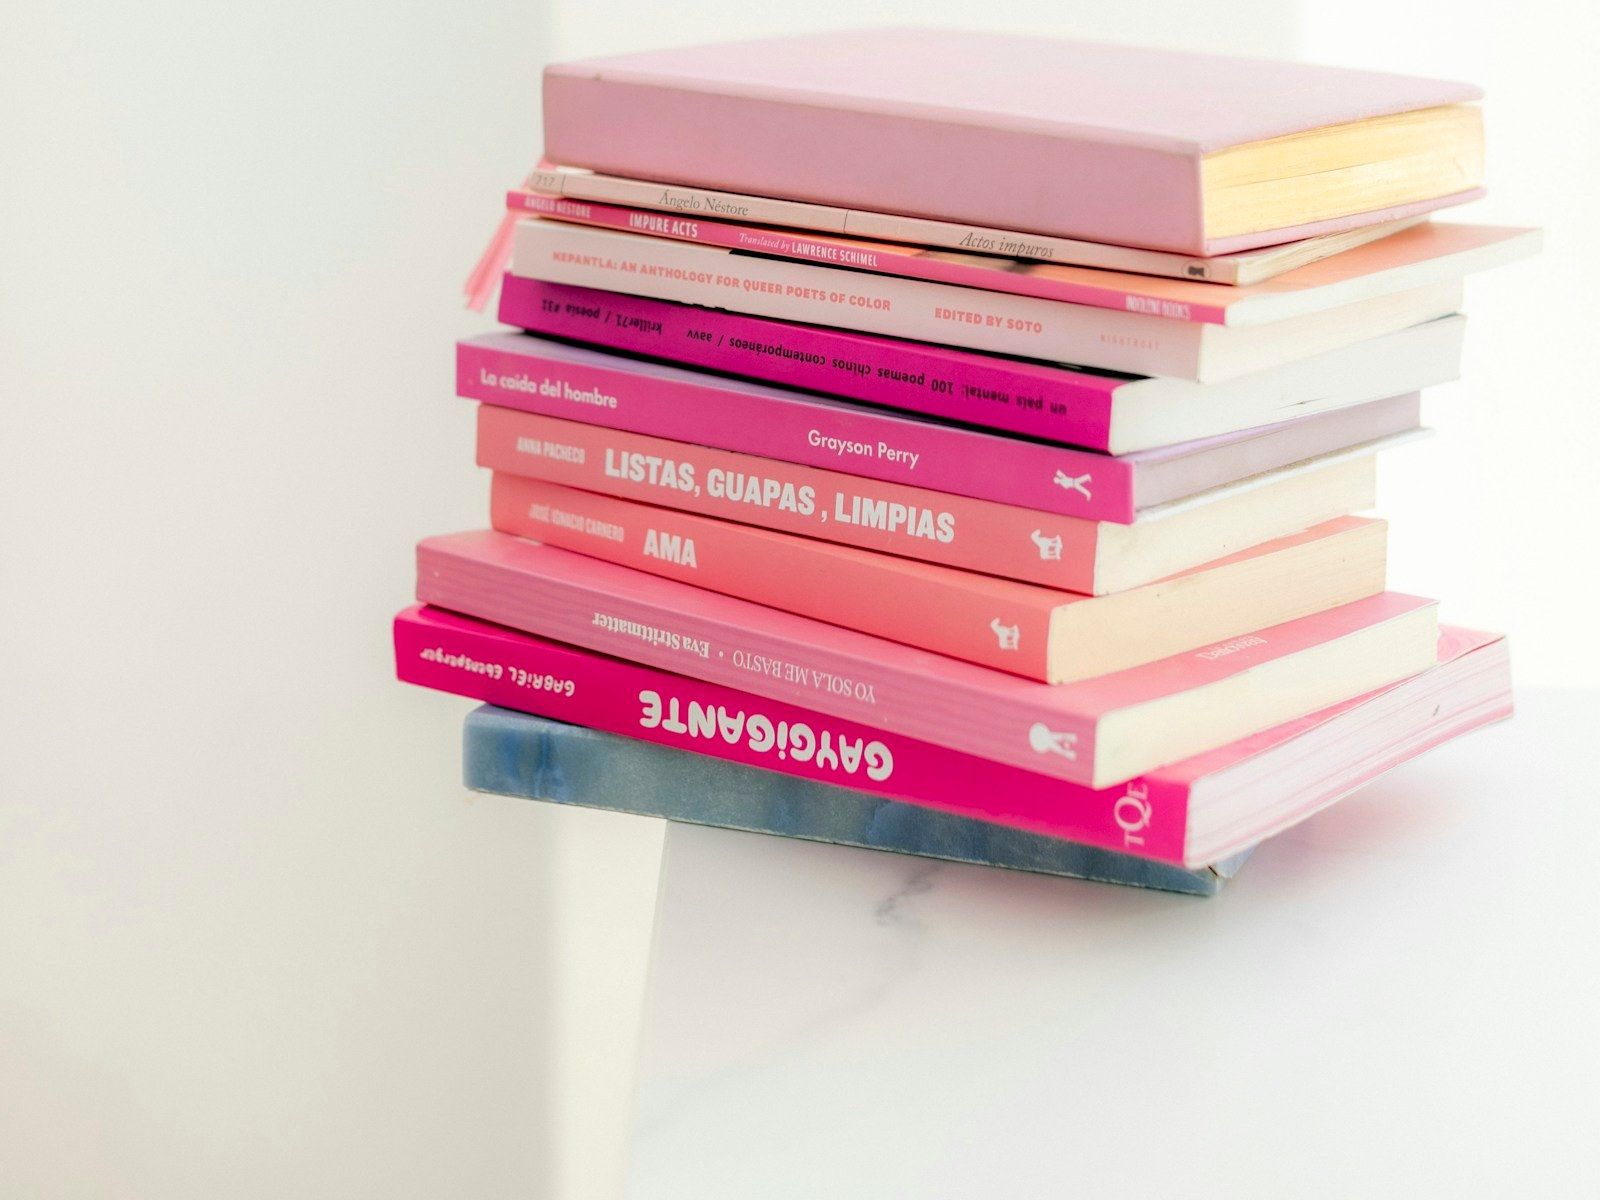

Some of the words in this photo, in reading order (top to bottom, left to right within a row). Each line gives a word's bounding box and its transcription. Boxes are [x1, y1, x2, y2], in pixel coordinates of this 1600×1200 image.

[659, 189, 701, 211] Ángelo
[703, 194, 749, 217] Néstore
[629, 213, 669, 233] IMPURE
[671, 220, 698, 237] ACTS
[739, 232, 781, 249] Translated
[781, 239, 791, 253] by
[792, 241, 837, 262] LAWRENCE
[839, 249, 878, 268] SCHIMEL
[959, 231, 995, 250] Actos
[999, 235, 1054, 259] impuros
[552, 250, 618, 270] NEPANTLA:
[620, 261, 638, 273] AN
[640, 262, 714, 284] ANTHOLOGY
[716, 271, 740, 288] FOR
[743, 275, 783, 295] QUEER
[785, 284, 826, 301] POETS
[829, 291, 846, 304] OF
[849, 294, 892, 311] COLOR
[615, 313, 663, 336] kriller71
[934, 307, 982, 325] EDITED
[985, 314, 1003, 327] BY
[1006, 318, 1043, 334] SOTO
[686, 328, 713, 343] aavv
[729, 337, 826, 366] contemporáneos
[832, 357, 871, 375] chinos
[877, 367, 925, 385] poemas
[480, 367, 497, 386] La
[499, 372, 537, 394] caída
[540, 378, 562, 399] del
[563, 382, 618, 409] hombre
[931, 378, 954, 395] 100
[960, 384, 1009, 403] mental:
[1049, 402, 1067, 415] un
[542, 441, 585, 465] PACHECO
[808, 430, 873, 459] Grayson
[878, 444, 919, 470] Perry
[605, 448, 701, 497] LISTAS,
[834, 492, 955, 543] LIMPIAS
[585, 518, 624, 542] CARNERO
[643, 528, 698, 568] AMA
[592, 611, 681, 650] Strittmatter
[420, 646, 503, 680] Ebensperger
[680, 639, 710, 660] Eva
[732, 648, 783, 678] BASTO
[784, 663, 810, 685] ME
[814, 671, 853, 698] SOLA
[855, 682, 876, 705] YO
